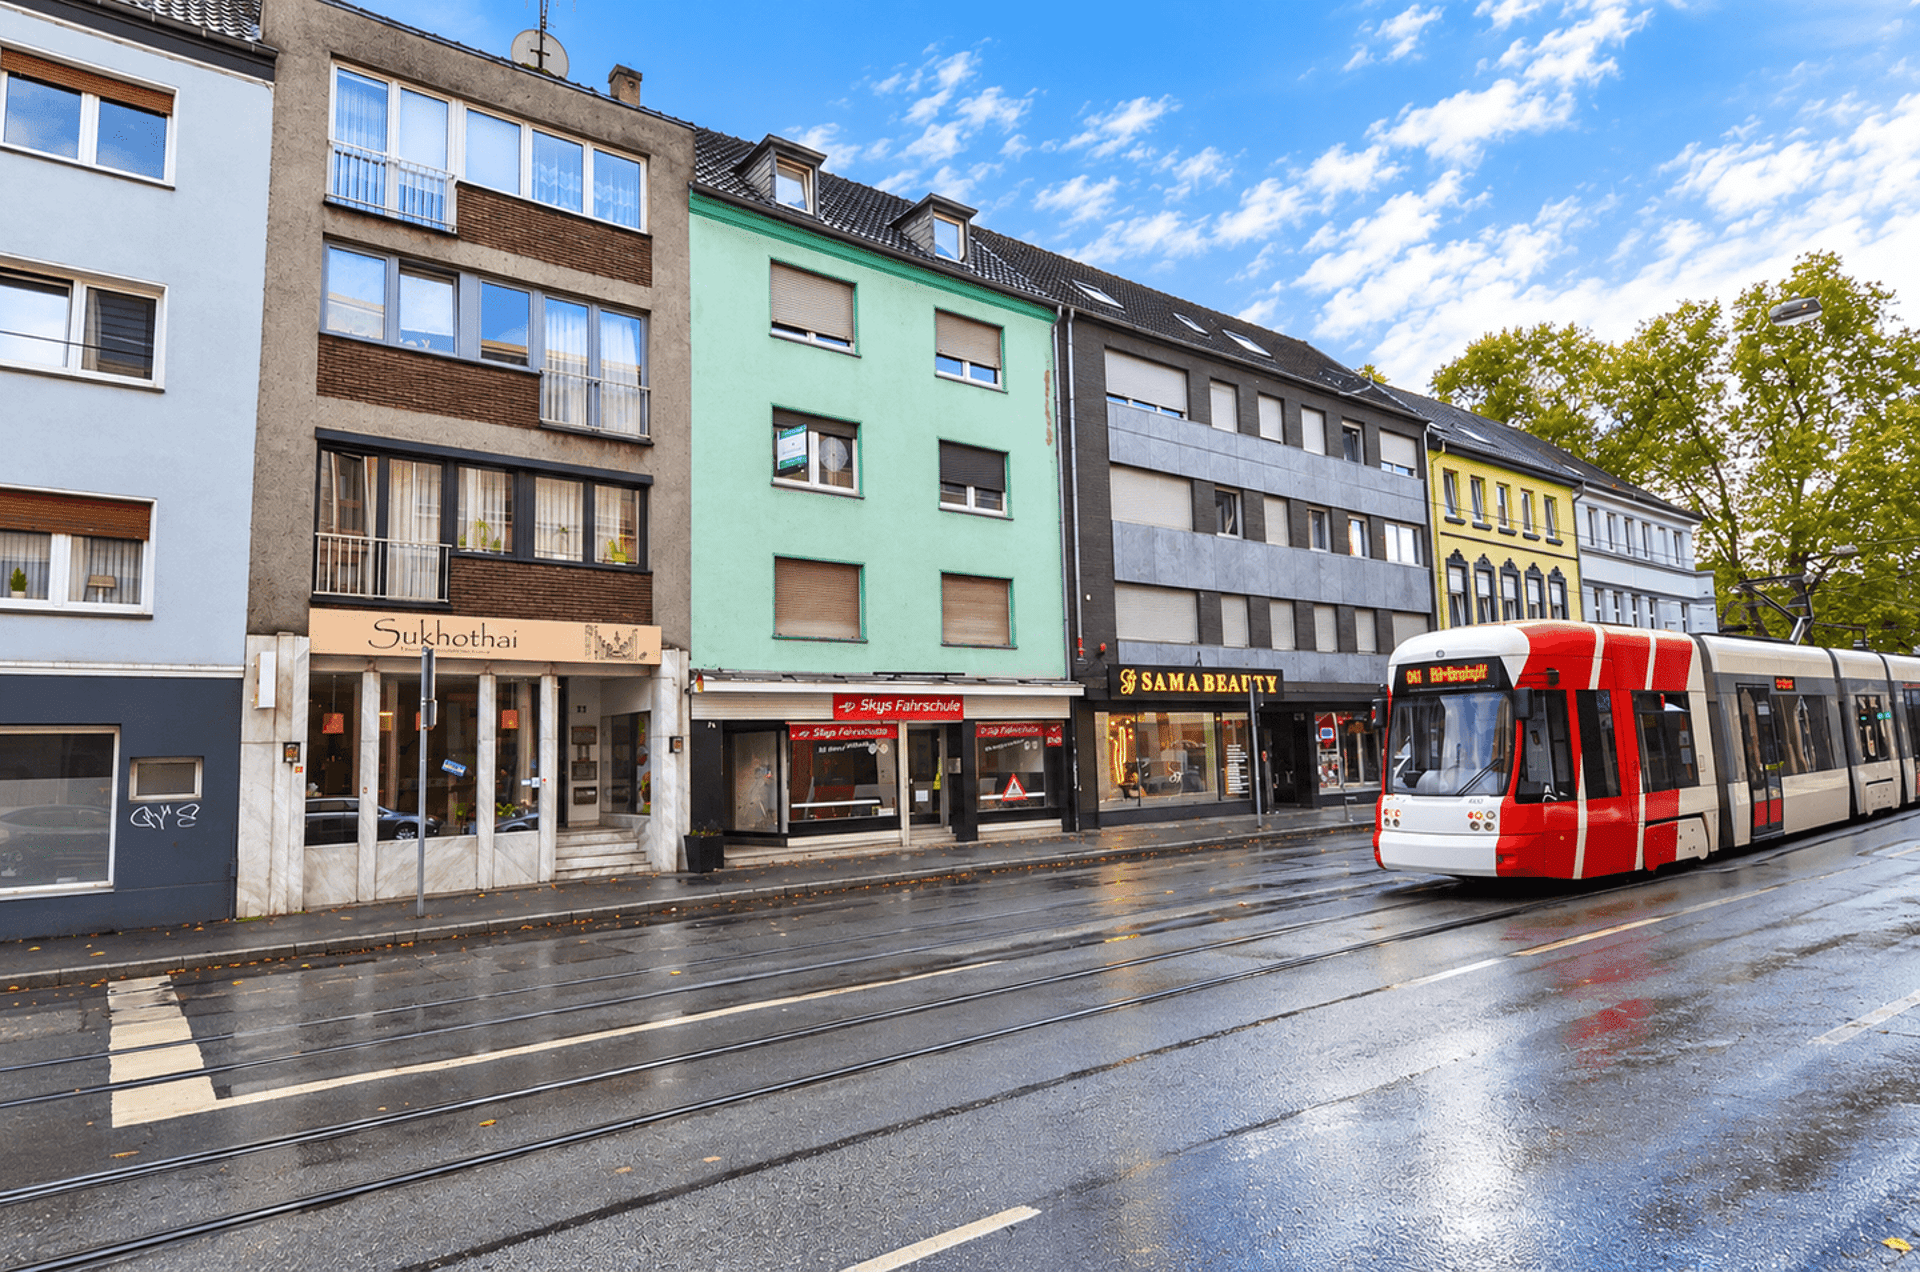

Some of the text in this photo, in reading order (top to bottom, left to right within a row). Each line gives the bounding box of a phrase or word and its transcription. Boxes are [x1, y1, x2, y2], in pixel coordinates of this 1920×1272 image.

[367, 617, 518, 650] Sukhothai
[1141, 671, 1200, 692] SAMA
[1202, 673, 1278, 694] BEAUTY
[860, 698, 961, 714] Skys Fahrschule
